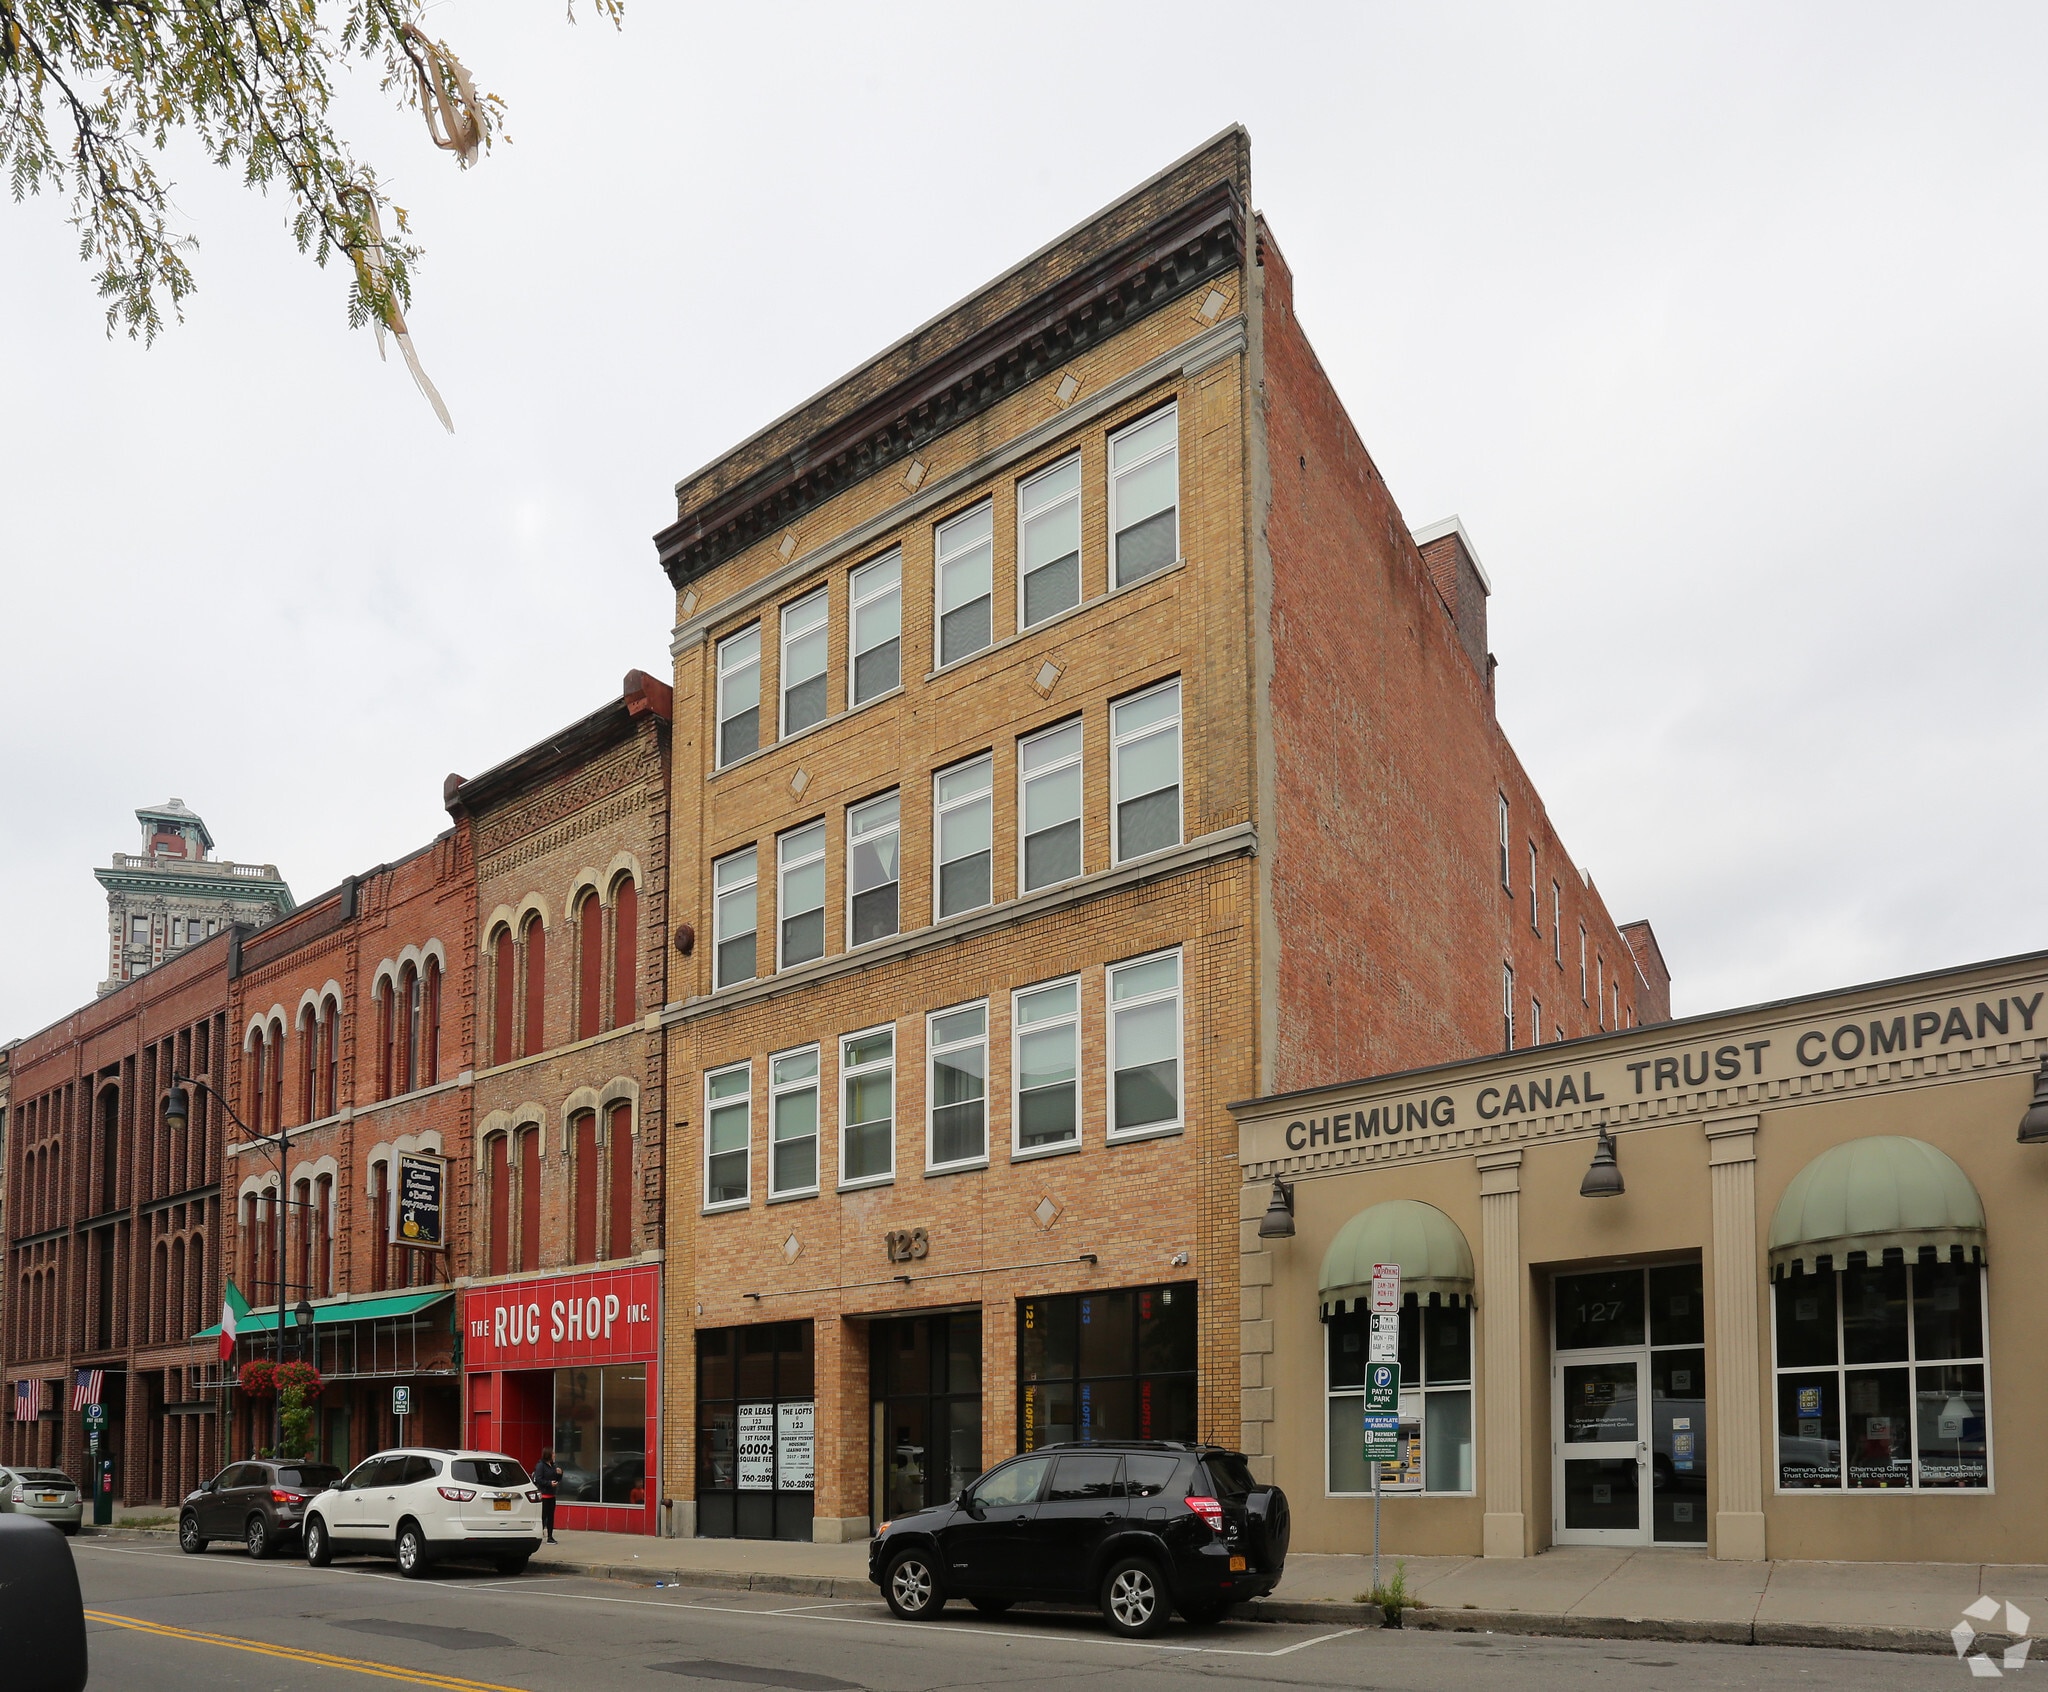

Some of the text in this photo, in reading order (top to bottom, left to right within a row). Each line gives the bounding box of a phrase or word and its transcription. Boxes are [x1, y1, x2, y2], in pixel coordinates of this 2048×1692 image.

[1285, 992, 2044, 1151] CHEMUNG CANAL TRUST COMPANY
[884, 1227, 928, 1262] 123
[471, 1294, 650, 1348] THE RUG SHOP INC.
[1025, 1305, 1034, 1329] 123
[1082, 1299, 1091, 1324] 123
[1578, 1301, 1622, 1323] 127
[1372, 1319, 1379, 1329] 15
[740, 1408, 753, 1416] FOR
[795, 1407, 813, 1415] LOFTS
[1025, 1404, 1034, 1429] LOFTS
[1082, 1401, 1091, 1427] LOFTS
[1921, 1465, 1959, 1473] Chemung
[1944, 1471, 1983, 1479] Company
